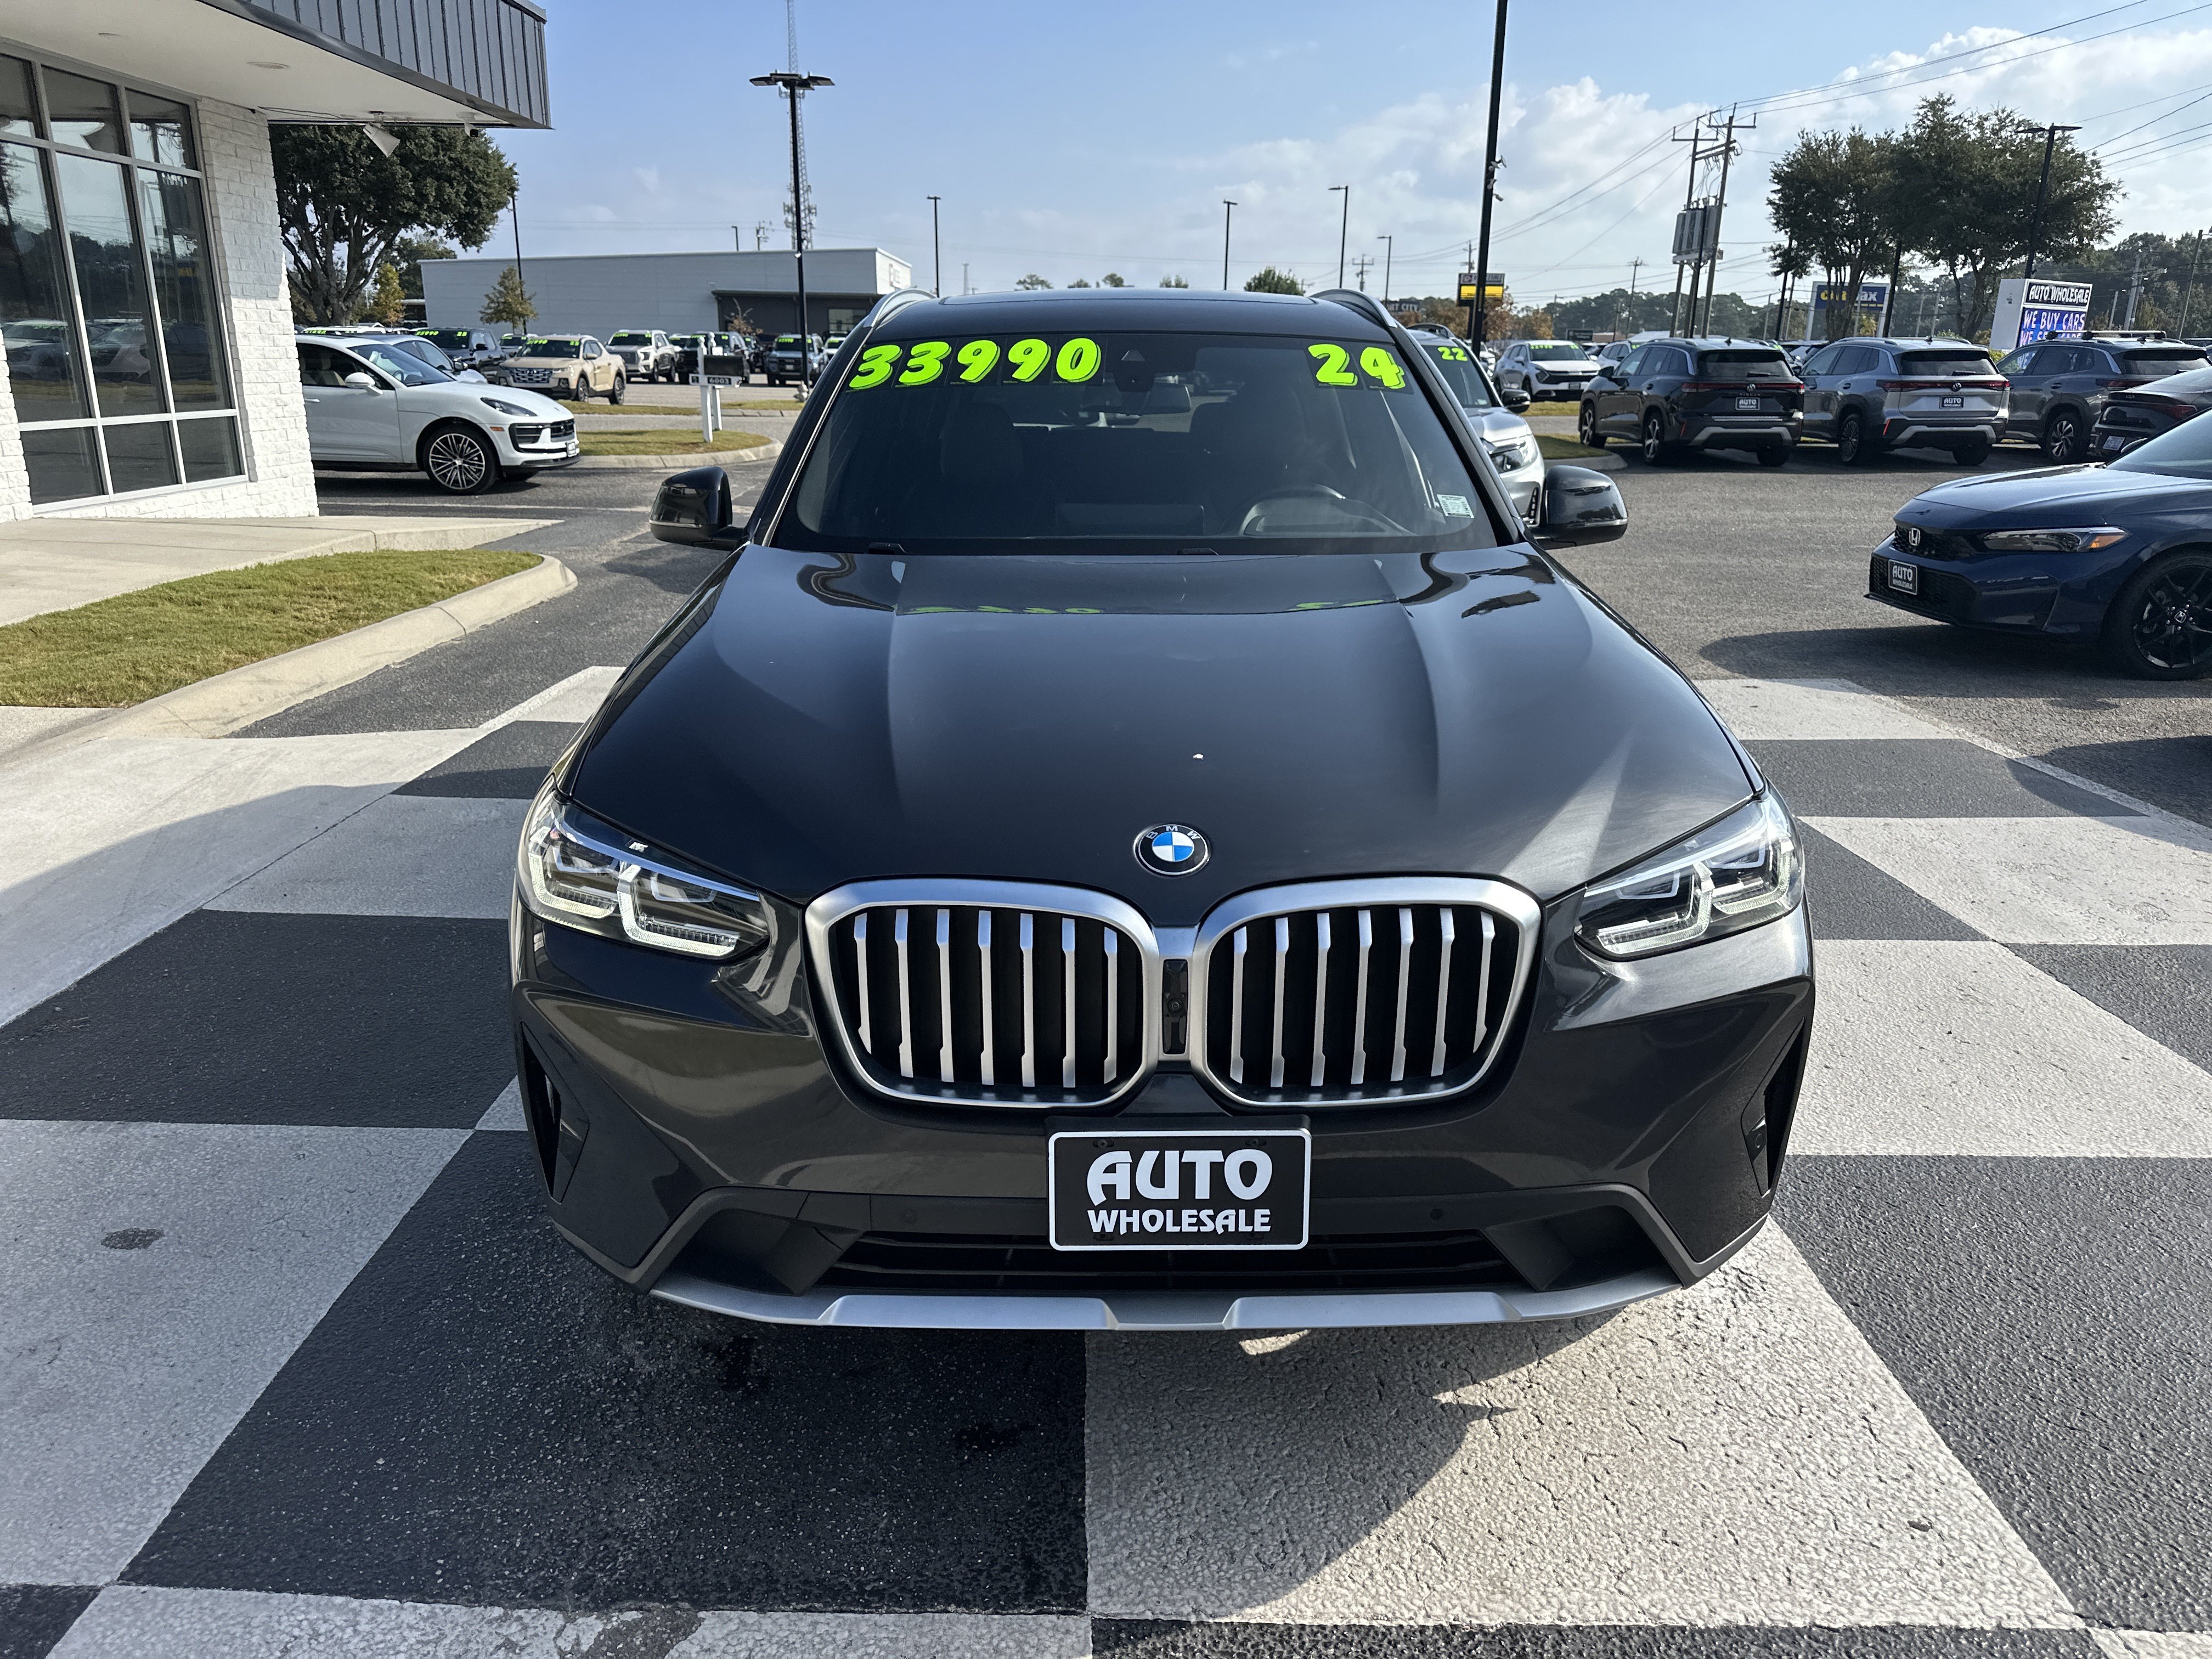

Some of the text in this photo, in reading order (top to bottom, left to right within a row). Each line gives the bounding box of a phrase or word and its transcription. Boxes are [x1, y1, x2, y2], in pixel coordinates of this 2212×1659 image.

[2029, 285, 2050, 302] AUTO
[2051, 286, 2090, 303] WHOLESALE
[2023, 309, 2086, 331] WE BUY CARS
[849, 337, 1406, 390] 33990 24
[1437, 346, 1468, 362] 22
[1892, 565, 1913, 582] AUTO
[1146, 825, 1200, 840] BMW
[1087, 1148, 1273, 1206] AUTO
[1087, 1209, 1271, 1235] WHOLESALE
